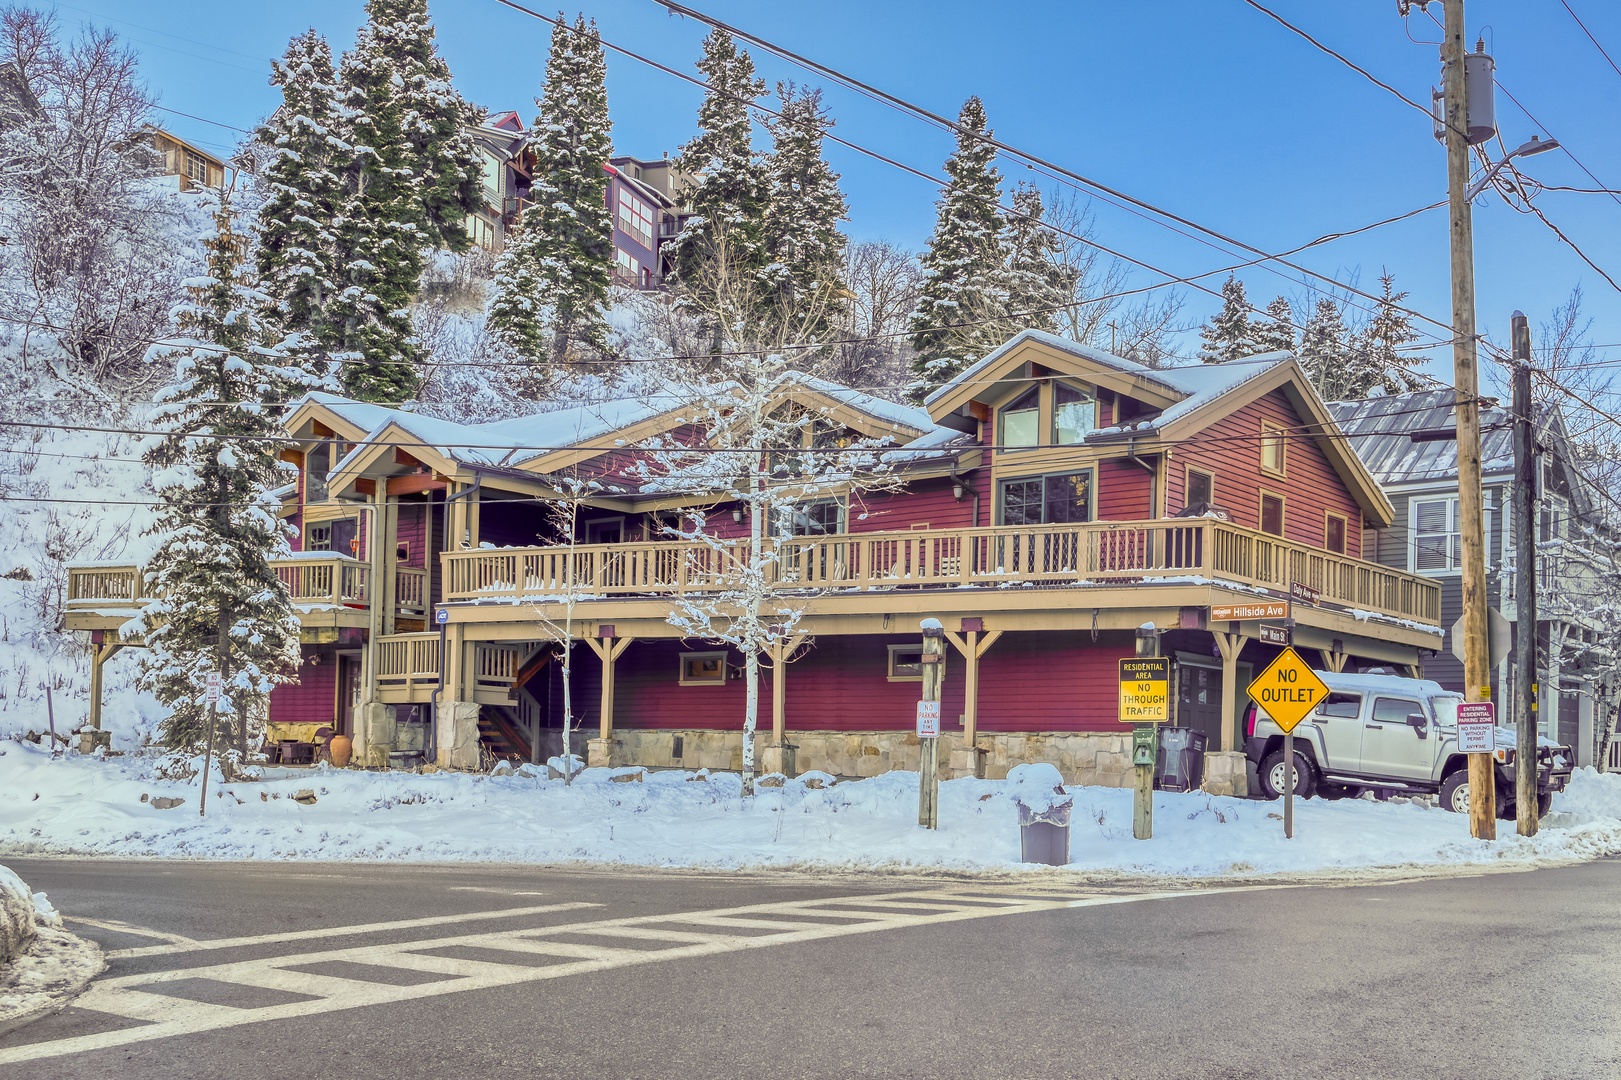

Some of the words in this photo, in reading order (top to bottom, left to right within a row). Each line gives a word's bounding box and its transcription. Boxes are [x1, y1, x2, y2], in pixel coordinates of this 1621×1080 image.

[1293, 584, 1303, 597] Daly
[1303, 587, 1311, 598] Ave
[1233, 607, 1265, 617] Hillside
[1266, 606, 1283, 615] Ave
[1269, 630, 1280, 641] Main
[1280, 632, 1285, 641] St
[1123, 663, 1164, 671] RESIDENTIAL
[1277, 668, 1298, 683] NO
[1137, 683, 1151, 692] NO
[1123, 695, 1165, 704] THROUGH
[1261, 688, 1315, 702] OUTLET
[1125, 706, 1162, 716] TRAFFIC
